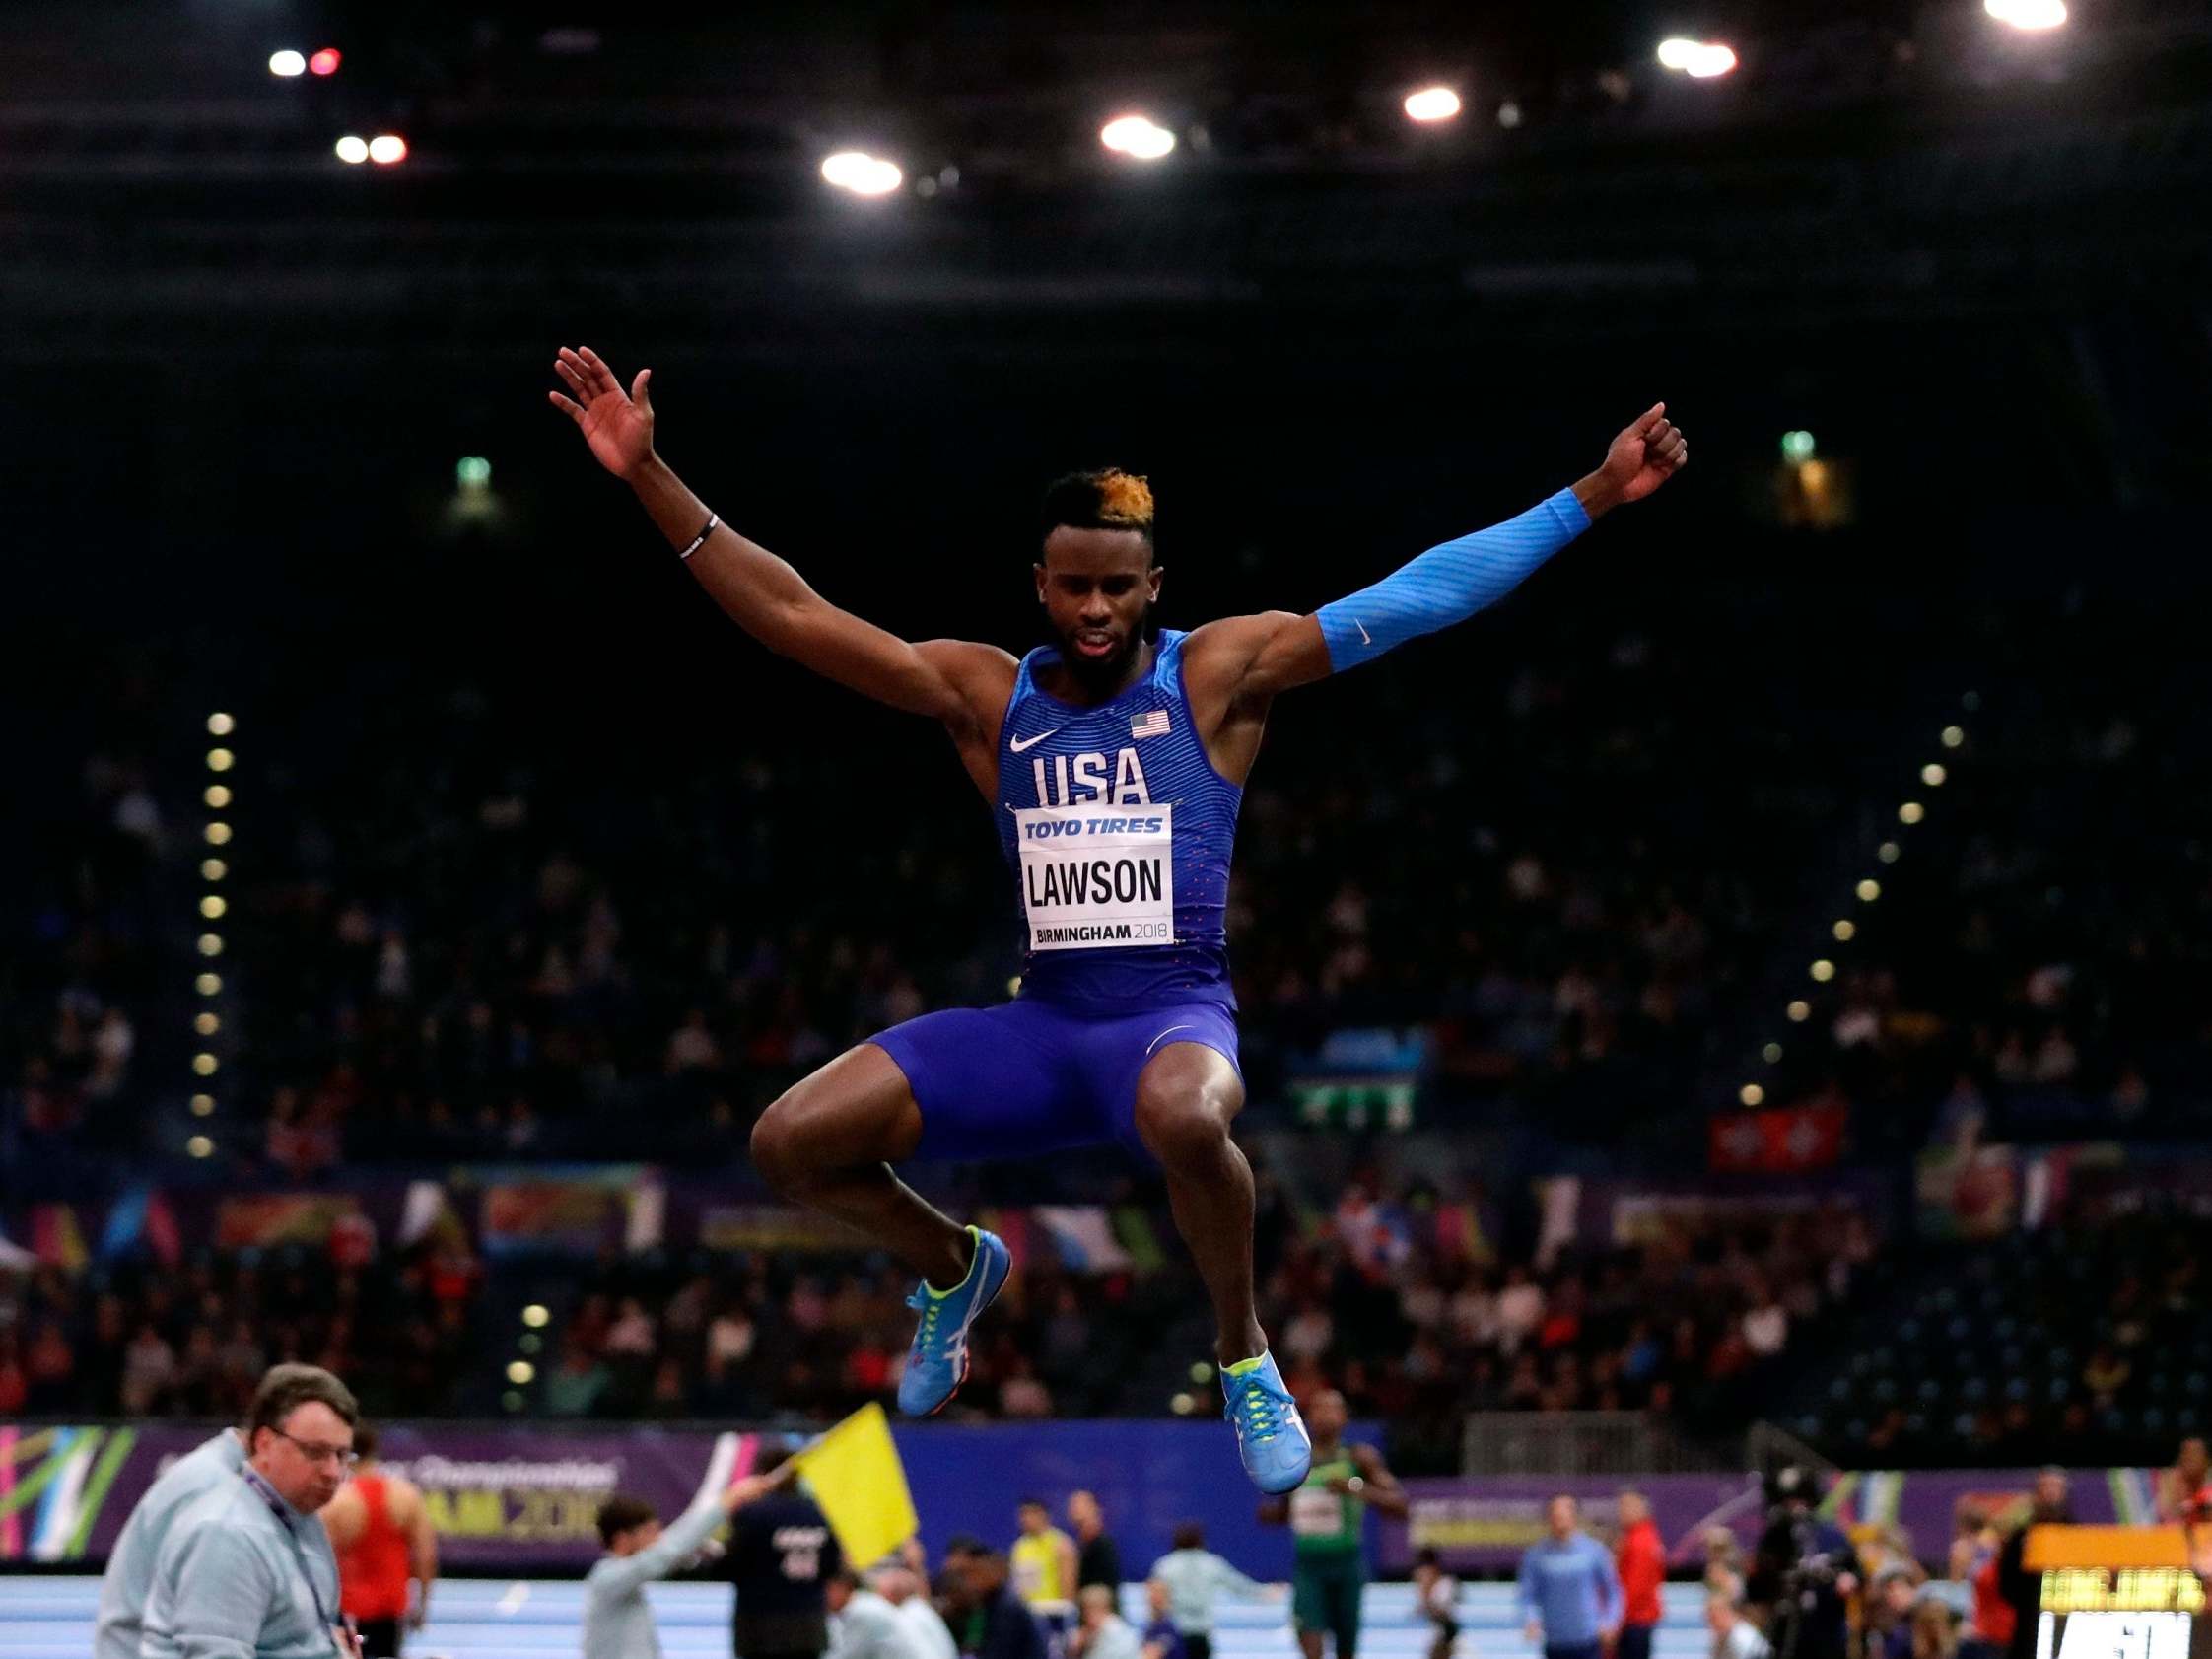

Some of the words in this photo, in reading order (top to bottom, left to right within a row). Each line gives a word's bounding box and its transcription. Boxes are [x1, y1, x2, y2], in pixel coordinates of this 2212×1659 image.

[1033, 747, 1151, 806] USA
[1025, 820, 1082, 839] TOYO
[1086, 817, 1163, 835] TIRES
[1027, 859, 1162, 907] LAWSON
[1036, 924, 1132, 943] BIRMINGHAM
[1134, 923, 1168, 938] 2018
